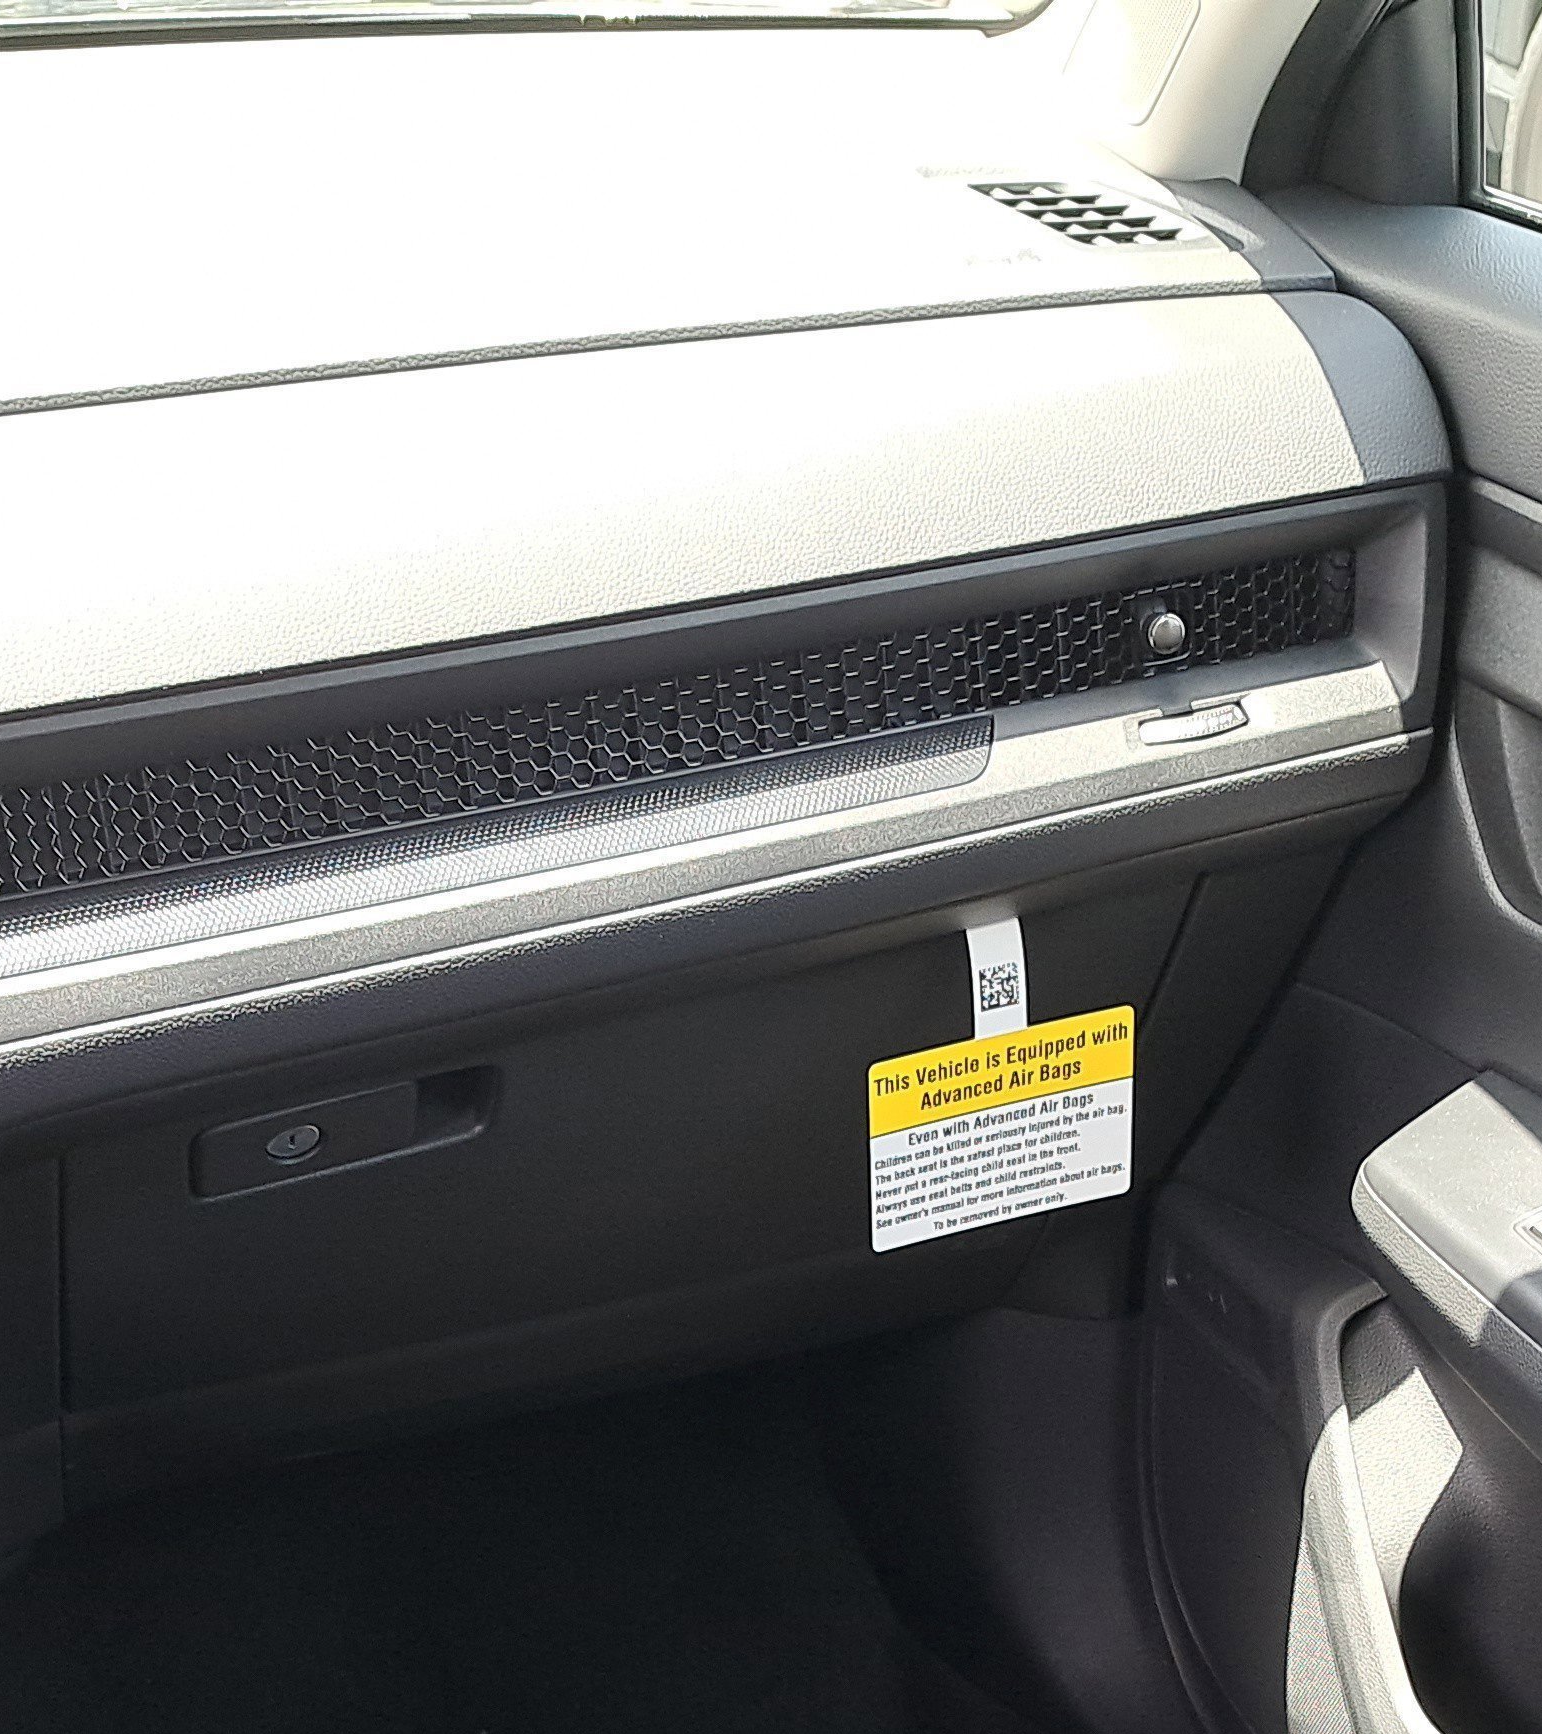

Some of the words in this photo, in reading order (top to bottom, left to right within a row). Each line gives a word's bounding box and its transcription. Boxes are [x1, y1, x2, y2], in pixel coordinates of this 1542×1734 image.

[873, 1073, 910, 1097] This
[916, 1057, 980, 1086] Vehicle
[986, 1051, 1001, 1070] is
[1006, 1030, 1086, 1065] Equipped
[1092, 1022, 1128, 1045] with
[920, 1074, 1004, 1111] Advanced
[1009, 1069, 1035, 1089] Air
[1040, 1059, 1082, 1081] Bags
[874, 1153, 913, 1170] Children
[915, 1149, 930, 1160] can
[933, 1145, 944, 1157] be
[1075, 1111, 1090, 1123] the
[908, 1128, 939, 1146] Even
[942, 1120, 970, 1137] with
[973, 1103, 1036, 1130] Advanced
[1039, 1100, 1059, 1115] Air
[1062, 1093, 1094, 1109] Bags
[875, 1173, 892, 1186] The
